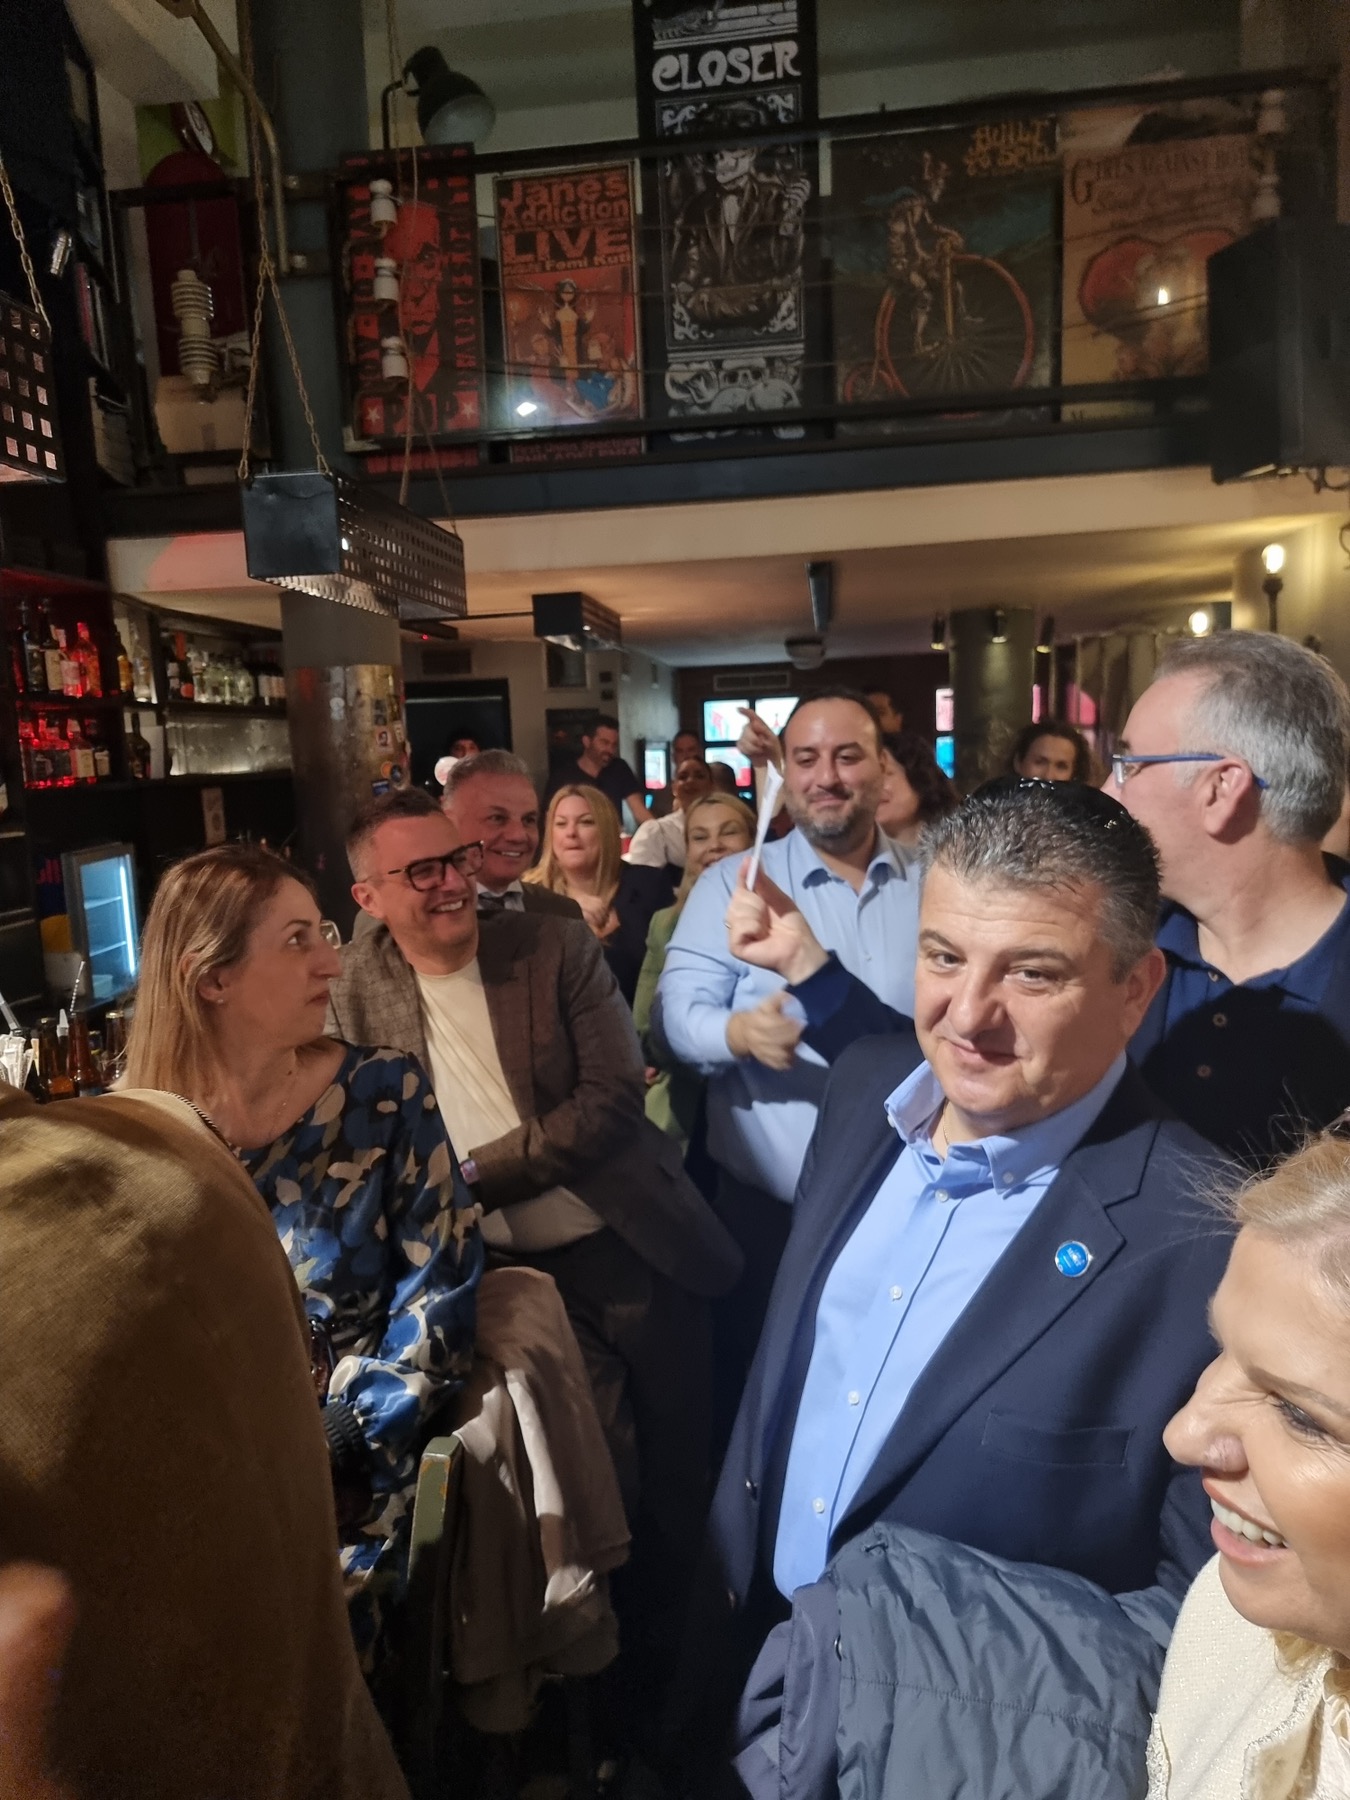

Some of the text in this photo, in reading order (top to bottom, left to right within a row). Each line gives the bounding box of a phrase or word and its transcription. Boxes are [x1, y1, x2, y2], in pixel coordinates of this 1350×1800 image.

[651, 40, 802, 92] CLOSER
[500, 173, 628, 209] Janes
[501, 199, 630, 230] Addiction
[501, 226, 630, 264] LIVE
